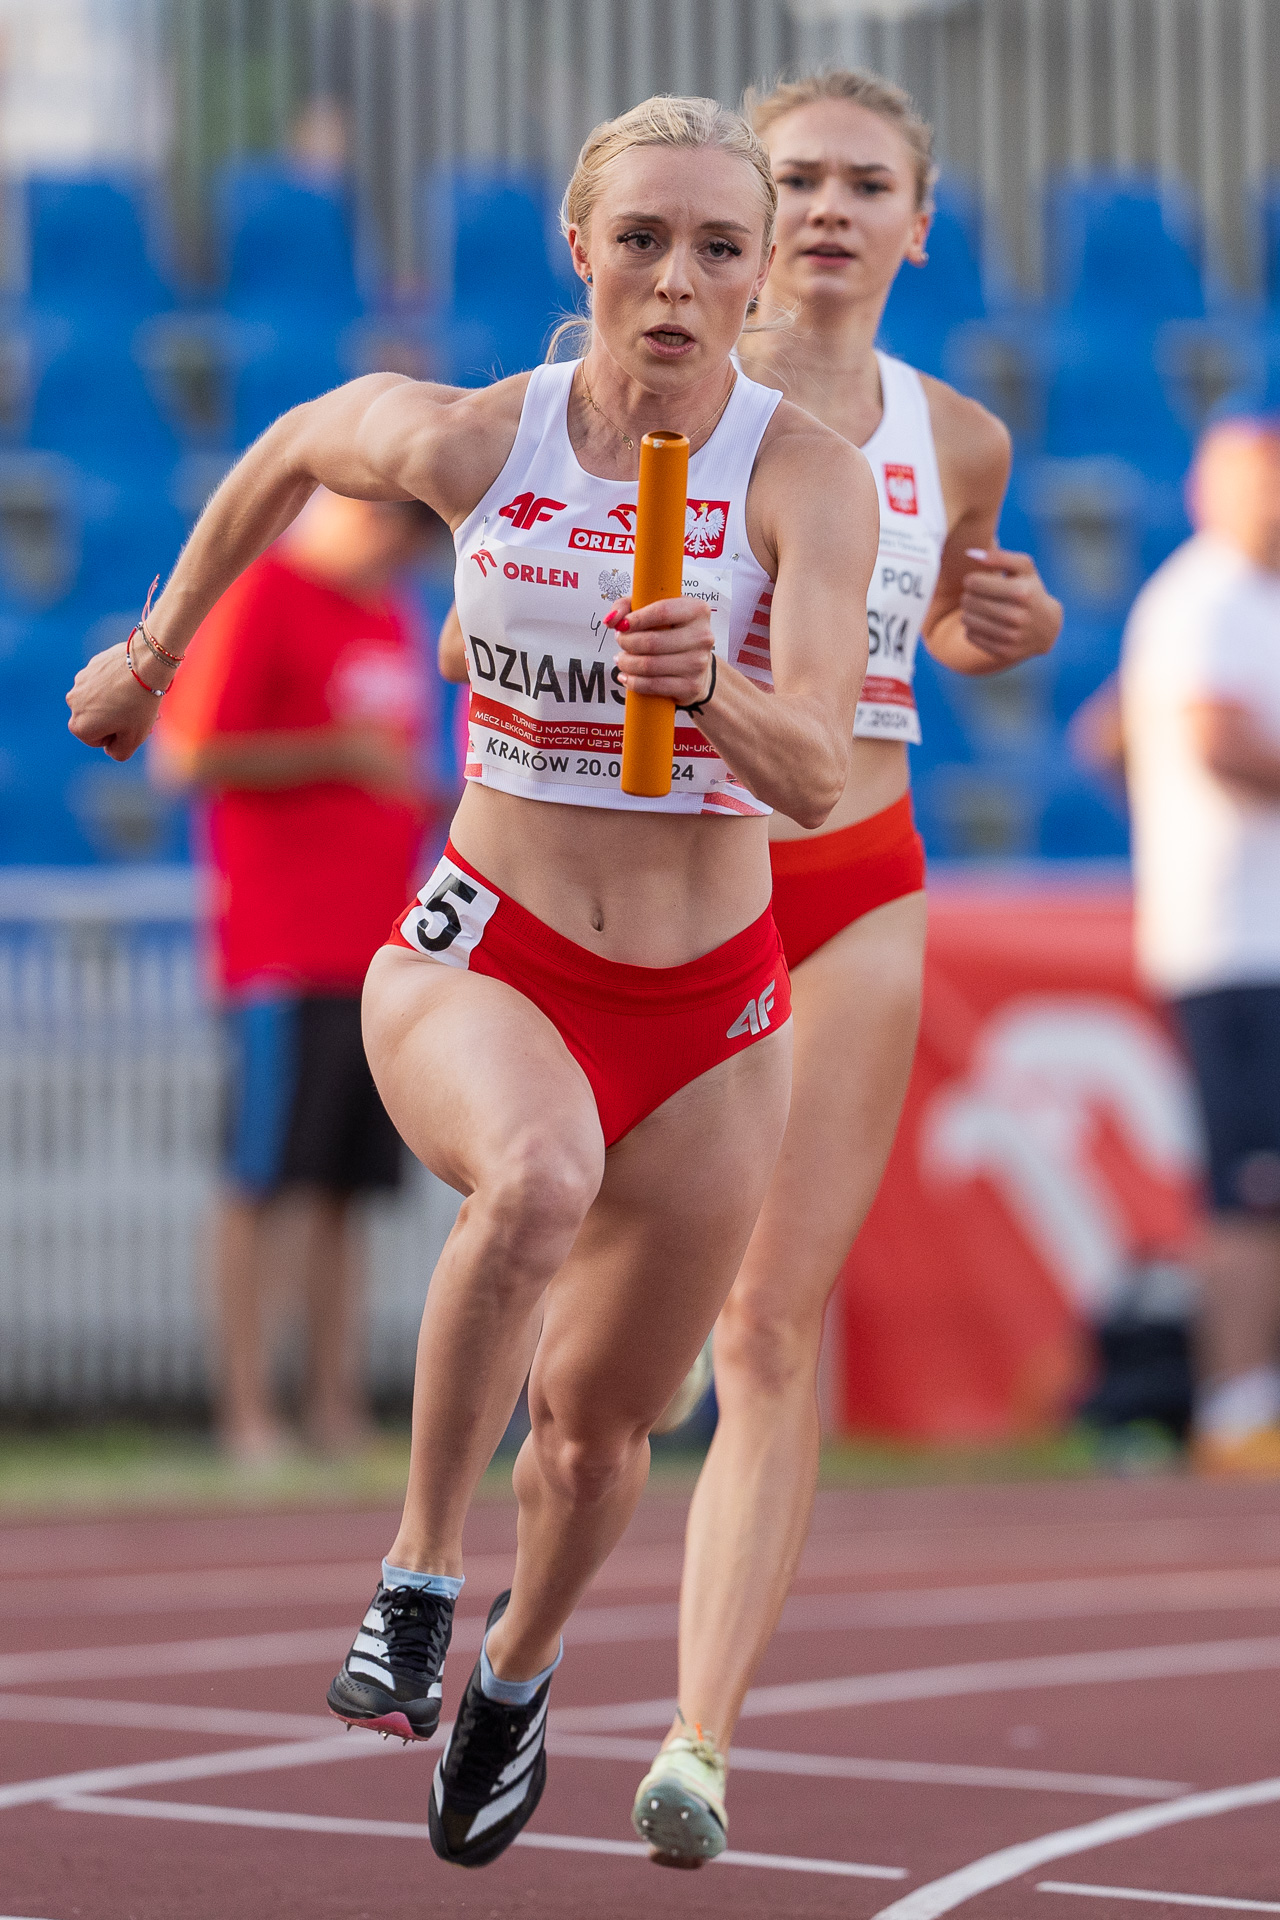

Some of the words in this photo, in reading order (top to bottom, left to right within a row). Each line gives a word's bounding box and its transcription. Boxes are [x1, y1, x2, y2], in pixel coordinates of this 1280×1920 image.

[573, 531, 636, 552] ORLEN
[502, 562, 579, 589] ORLEN
[882, 567, 925, 600] POL
[469, 635, 627, 706] DZIAMS
[474, 711, 500, 725] MECZ
[500, 720, 585, 746] LEKKOATLETYCZNY
[587, 739, 611, 748] U23
[511, 713, 544, 733] TURNIEJ
[545, 726, 588, 735] NADZIEI
[591, 727, 624, 737] OLIMP
[485, 736, 570, 774] KRAKÓW
[416, 872, 478, 952] 5
